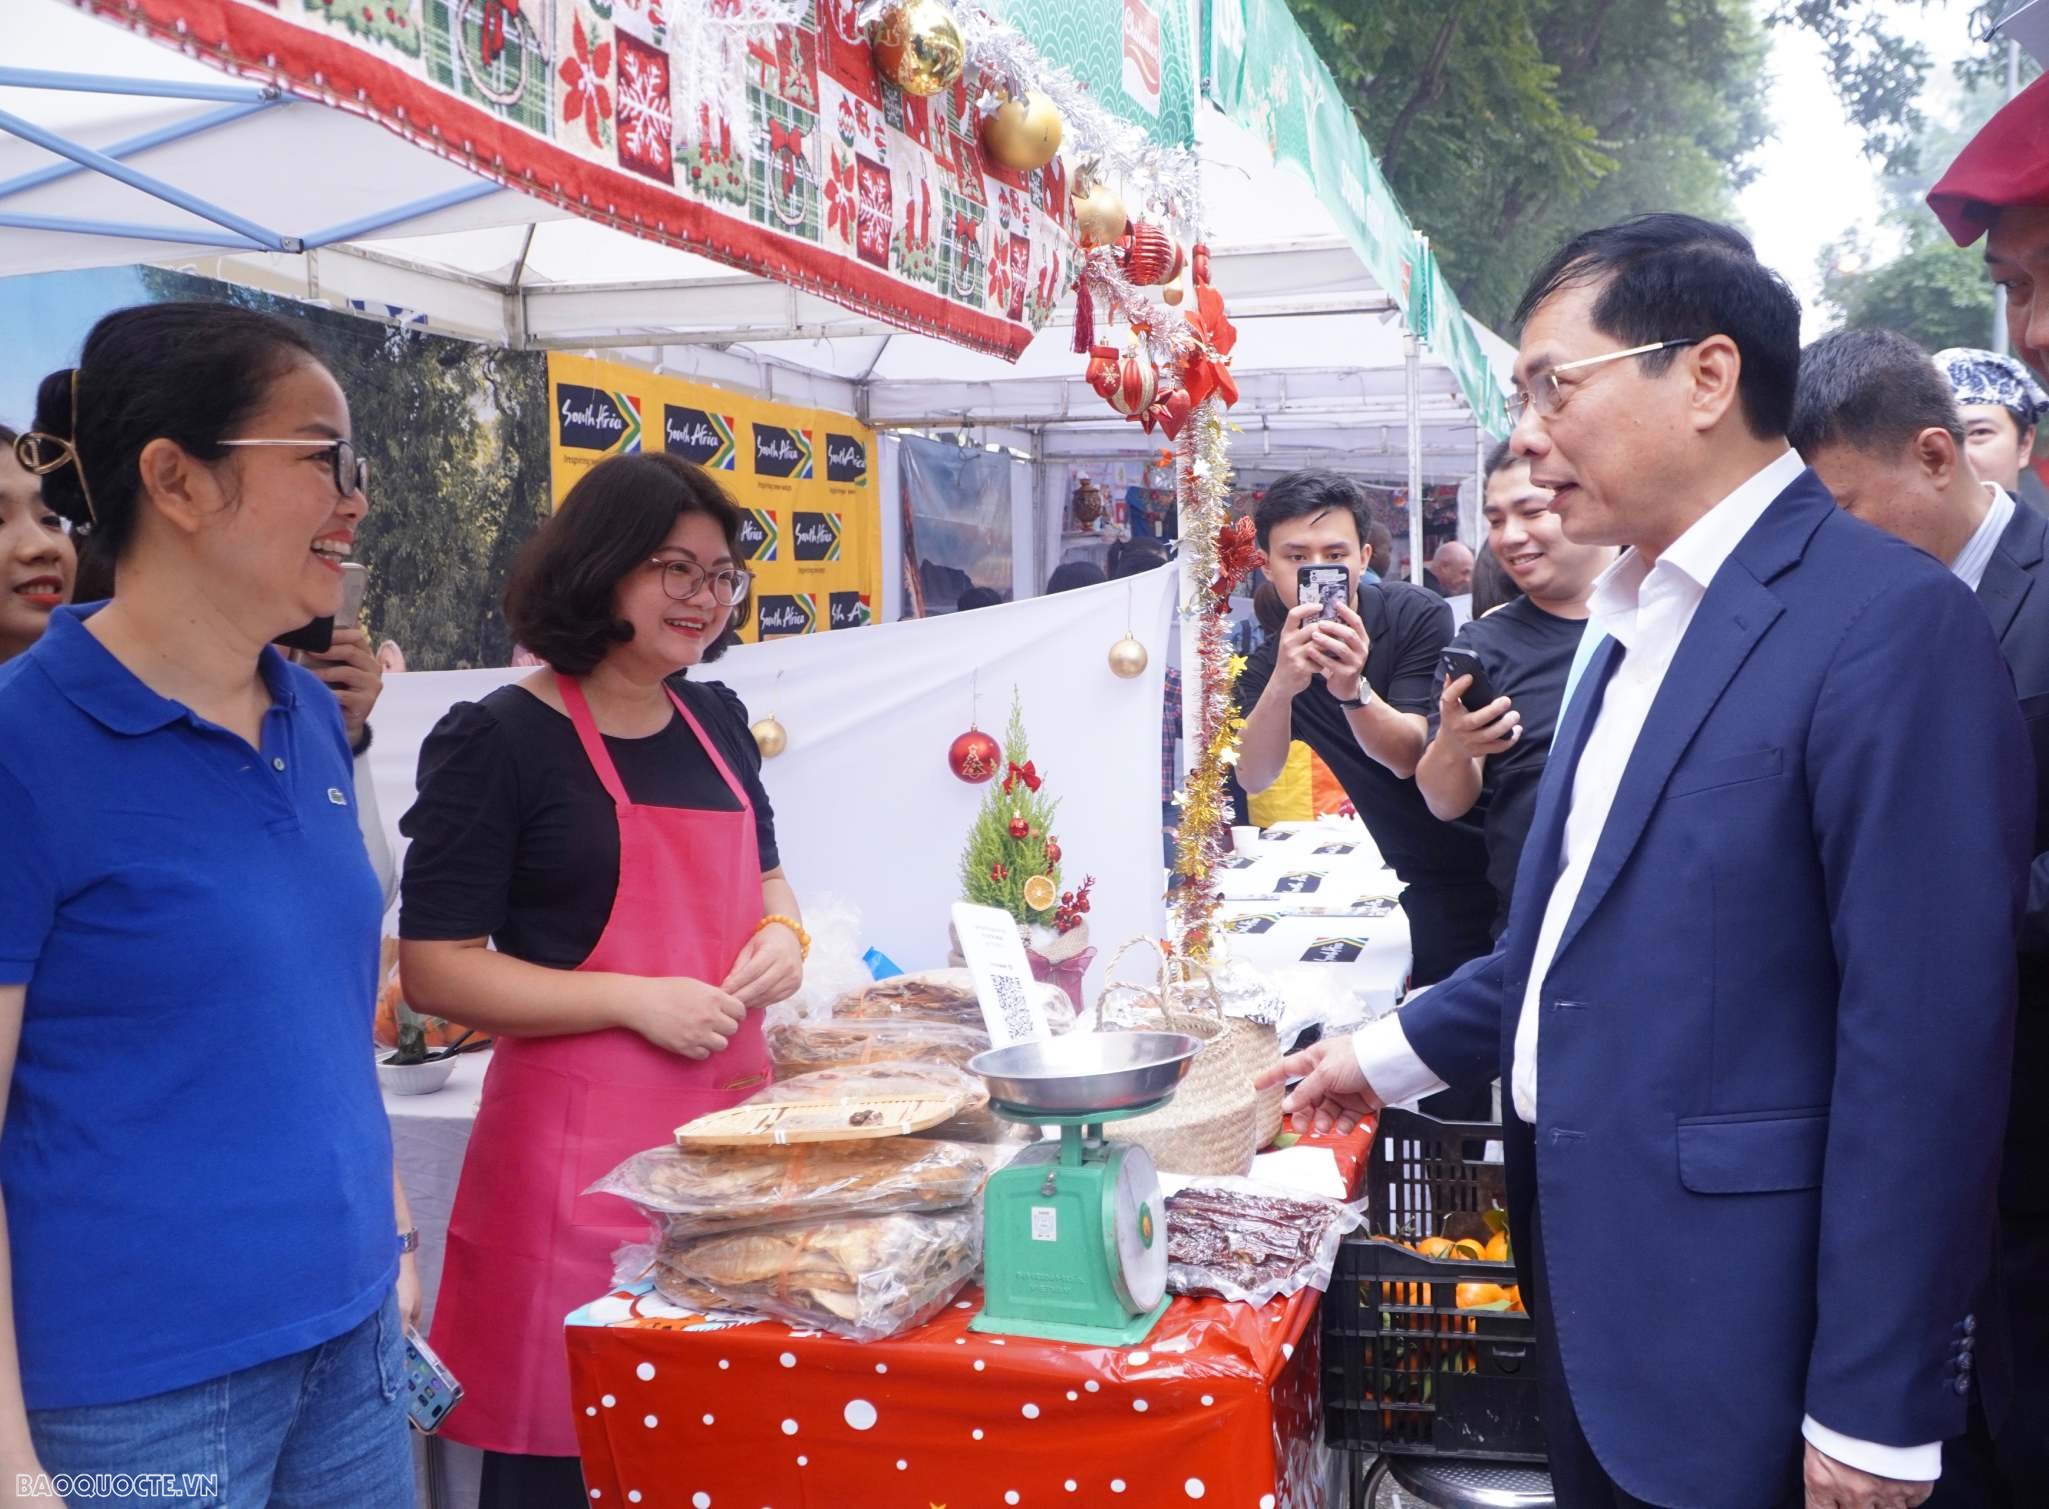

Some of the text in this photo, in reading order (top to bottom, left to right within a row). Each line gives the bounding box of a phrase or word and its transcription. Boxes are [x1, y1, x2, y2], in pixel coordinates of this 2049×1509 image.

[562, 399, 595, 427] South
[666, 418, 718, 446] South Africa
[757, 435, 798, 460] South Africa
[741, 520, 762, 542] Africa
[795, 523, 815, 545] South
[760, 607, 782, 630] South
[783, 606, 805, 628] Africa
